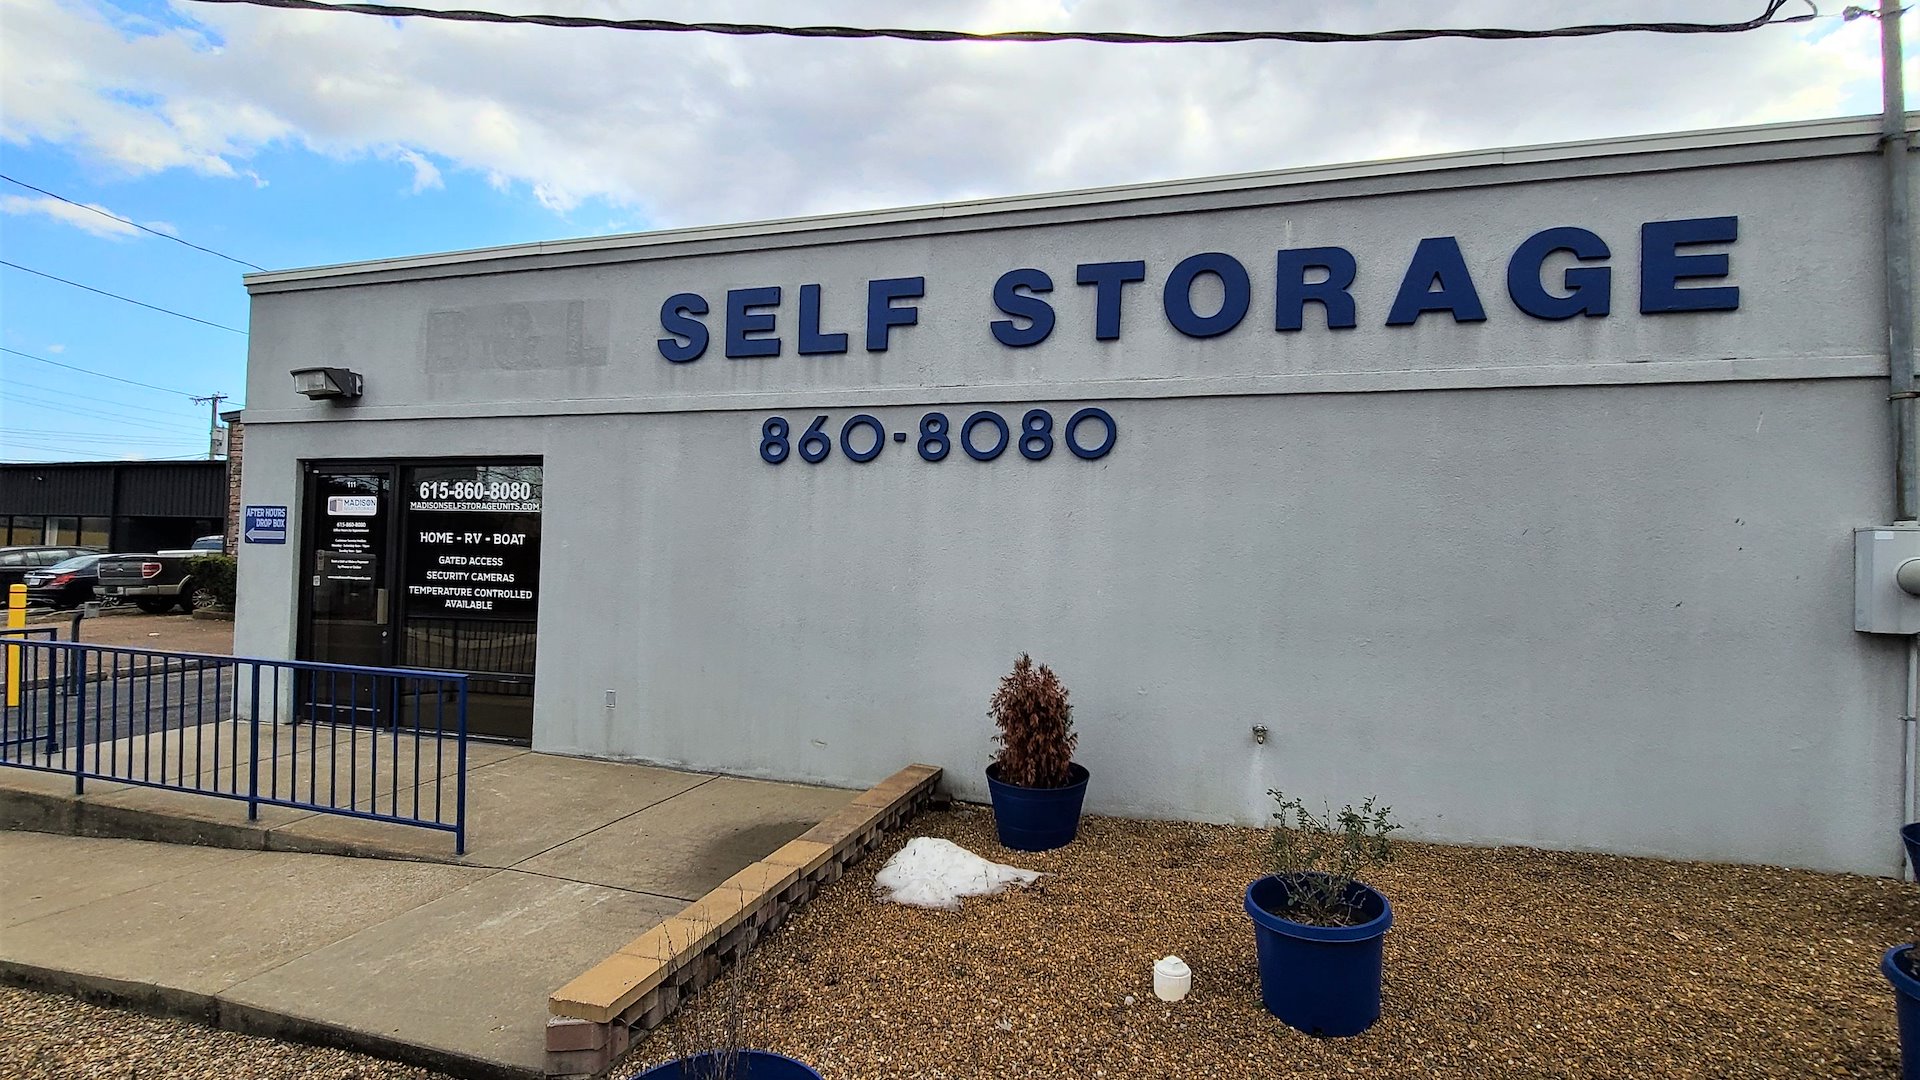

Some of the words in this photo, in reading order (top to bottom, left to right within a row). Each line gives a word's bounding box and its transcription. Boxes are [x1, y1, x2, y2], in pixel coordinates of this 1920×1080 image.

[657, 276, 925, 363] SELF
[990, 216, 1741, 348] STORAGE
[760, 407, 1117, 464] 860-8080
[419, 481, 531, 500] 615-860-8080
[344, 499, 376, 507] MADISON
[409, 501, 540, 512] MADISONSELFSTORAGEUNITS.COM
[246, 508, 265, 517] AFTER
[265, 508, 286, 518] HOURS
[256, 518, 272, 528] DROP
[272, 519, 286, 528] BOX
[420, 532, 454, 544] HOME
[464, 533, 482, 544] RV
[493, 533, 526, 545] BOAT
[438, 556, 467, 565] GATED
[468, 557, 503, 566] ACCESS
[426, 571, 469, 580] SECURITY
[471, 572, 514, 582] CAMERAS
[409, 586, 472, 597] TEMPERATURE
[474, 588, 532, 599] CONTROLLED
[445, 600, 493, 610] AVAILABLE
